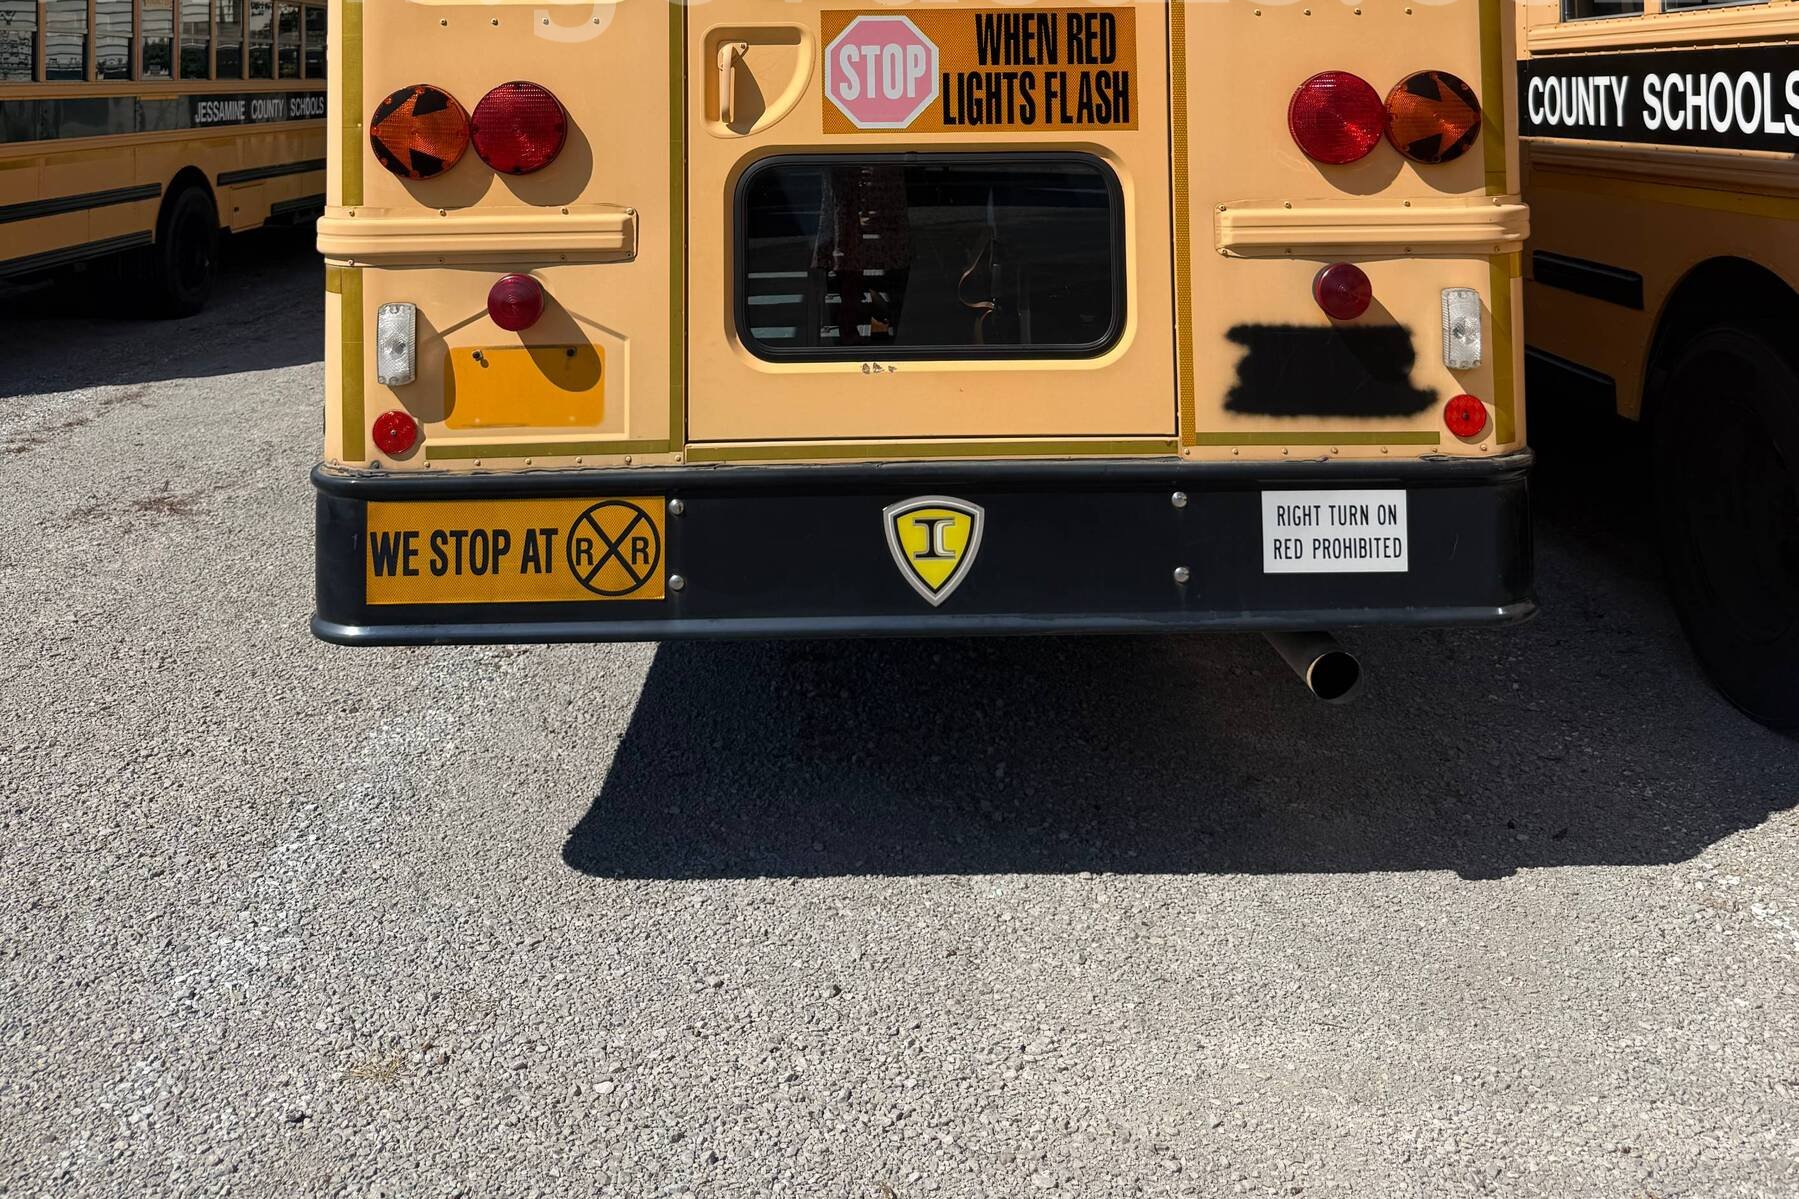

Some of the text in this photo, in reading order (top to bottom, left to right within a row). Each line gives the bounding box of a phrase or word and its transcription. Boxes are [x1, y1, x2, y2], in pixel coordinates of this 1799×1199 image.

[975, 12, 1117, 66] WHEN RED
[839, 43, 927, 101] STOP
[942, 70, 1130, 125] LIGHTS FLASH
[194, 96, 325, 123] JESSAMINE COUNTY SCHOOLS
[1528, 70, 1799, 137] COUNTY SCHOOLS
[1277, 504, 1397, 526] RIGHT TURN ON
[370, 530, 420, 577] WE
[429, 529, 511, 577] STOP
[520, 528, 558, 574] AT
[1273, 537, 1402, 560] RED PROHIBITED
